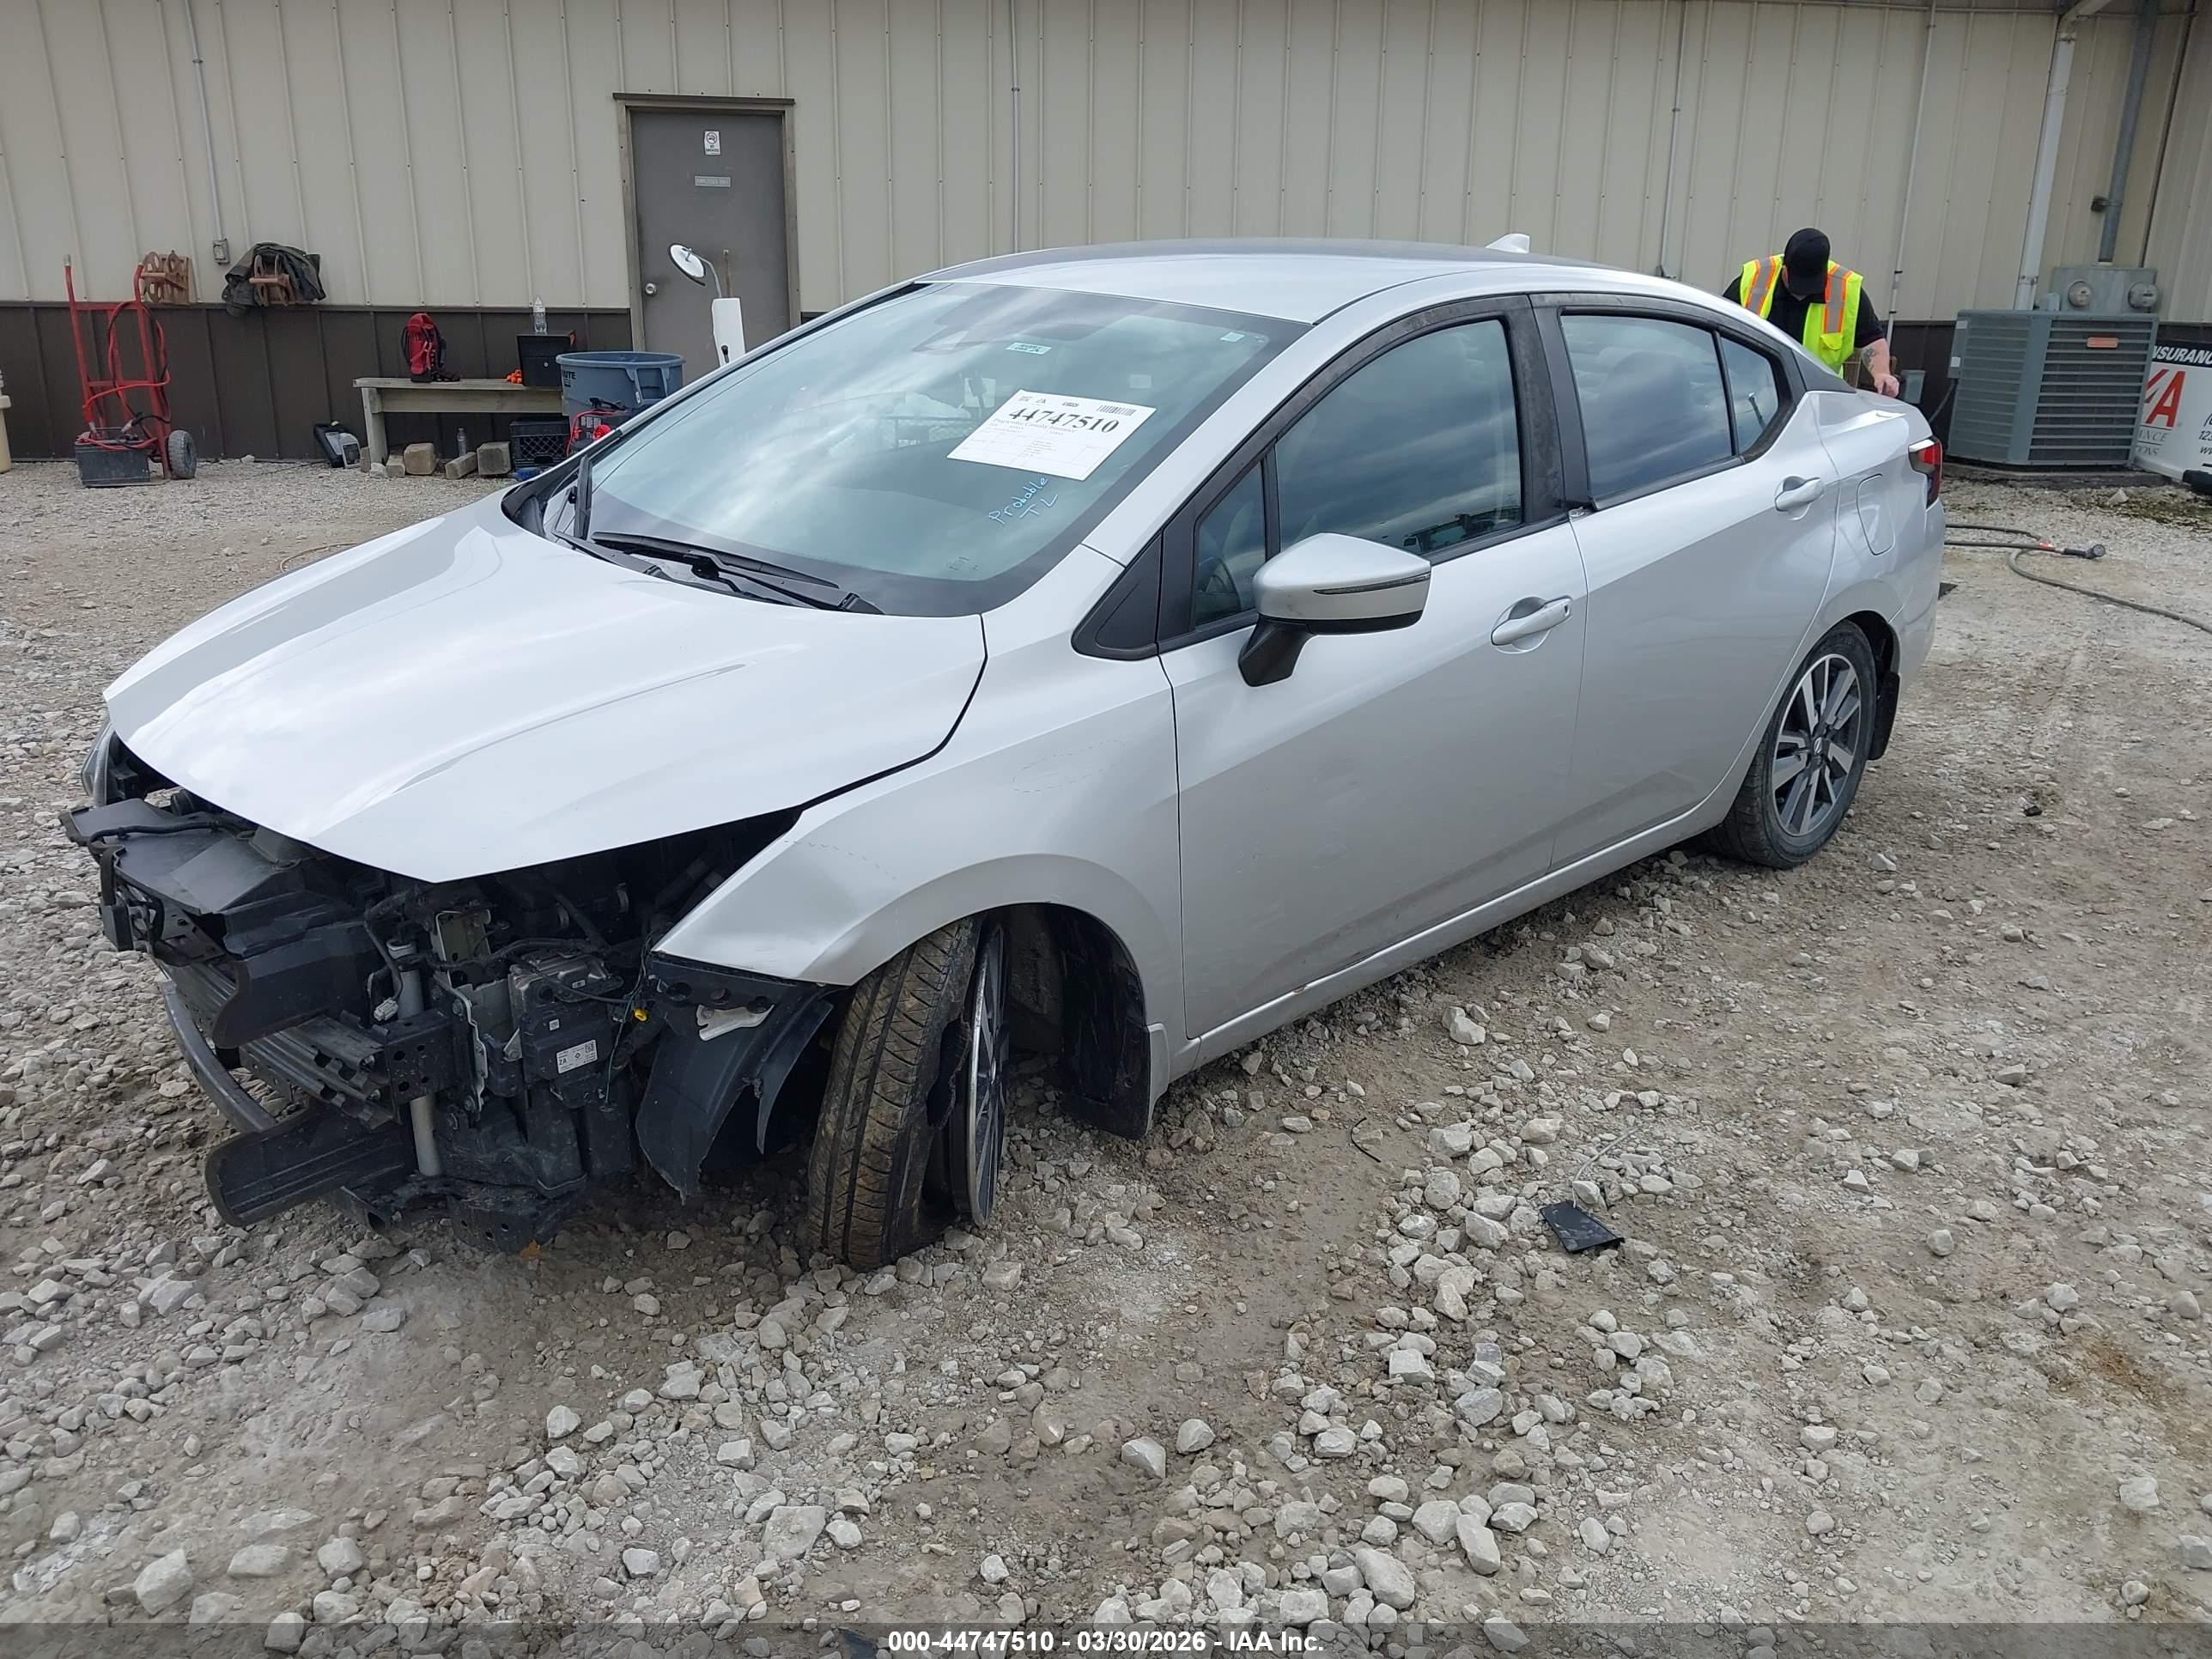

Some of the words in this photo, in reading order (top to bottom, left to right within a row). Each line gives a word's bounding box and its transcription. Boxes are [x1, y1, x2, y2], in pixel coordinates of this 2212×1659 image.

[2152, 345, 2212, 364] NSURANC
[1009, 407, 1120, 434] 44747510
[988, 477, 1048, 525] Probable
